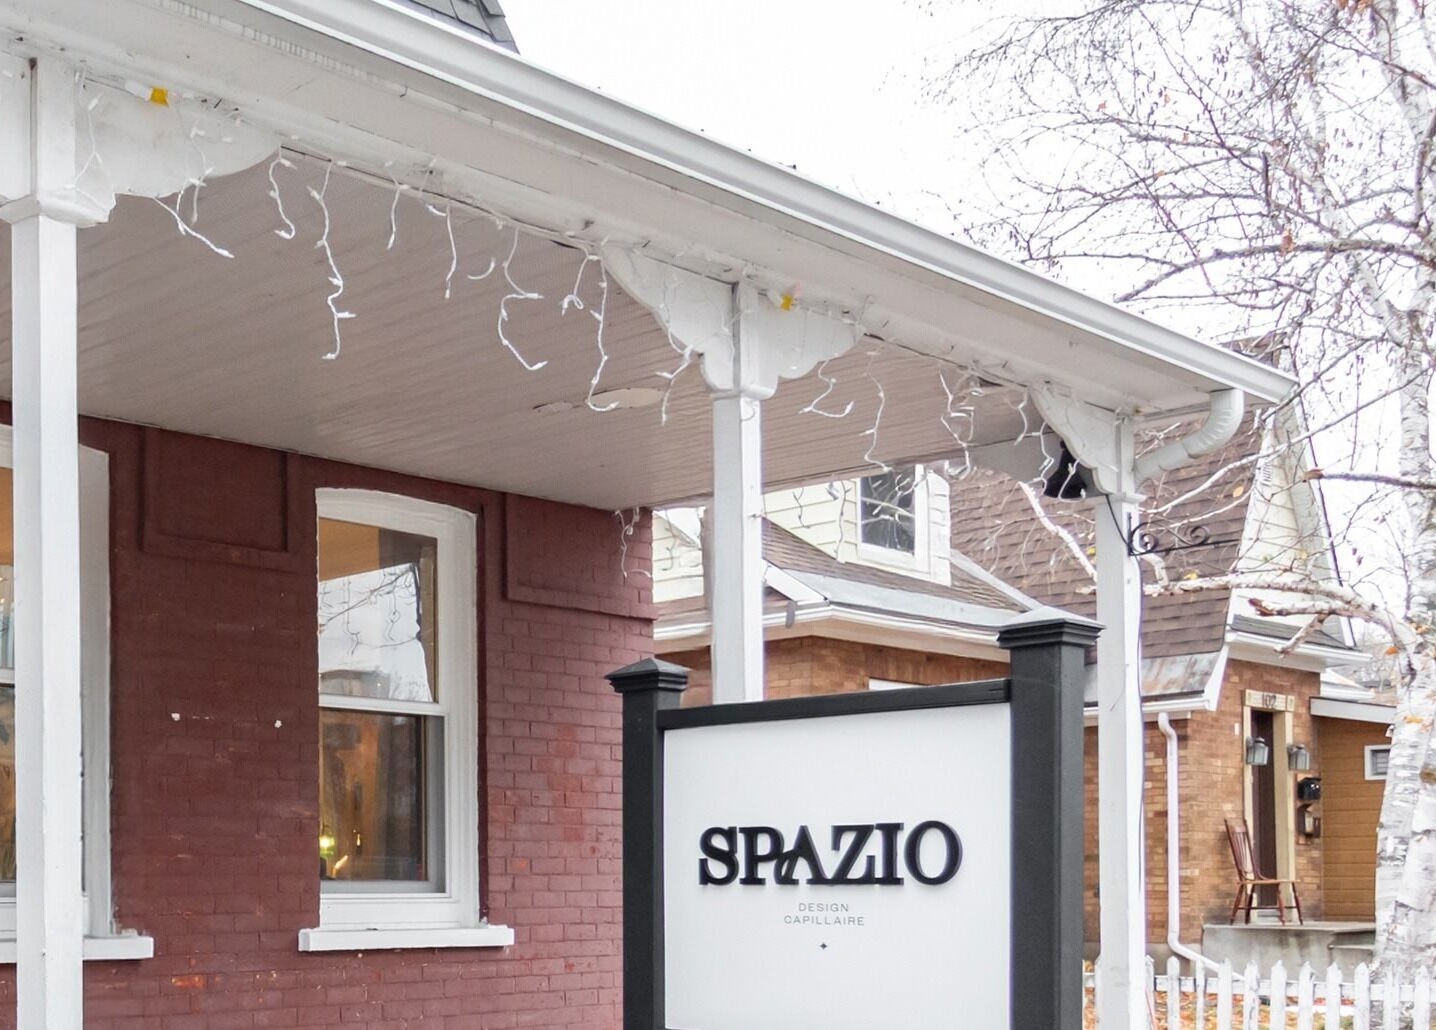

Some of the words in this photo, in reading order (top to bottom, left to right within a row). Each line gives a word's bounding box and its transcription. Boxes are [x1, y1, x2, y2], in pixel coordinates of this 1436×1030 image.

[698, 820, 963, 886] SPAZIO
[798, 902, 849, 913] DESIGN
[783, 915, 865, 926] CAPILLAIRE
